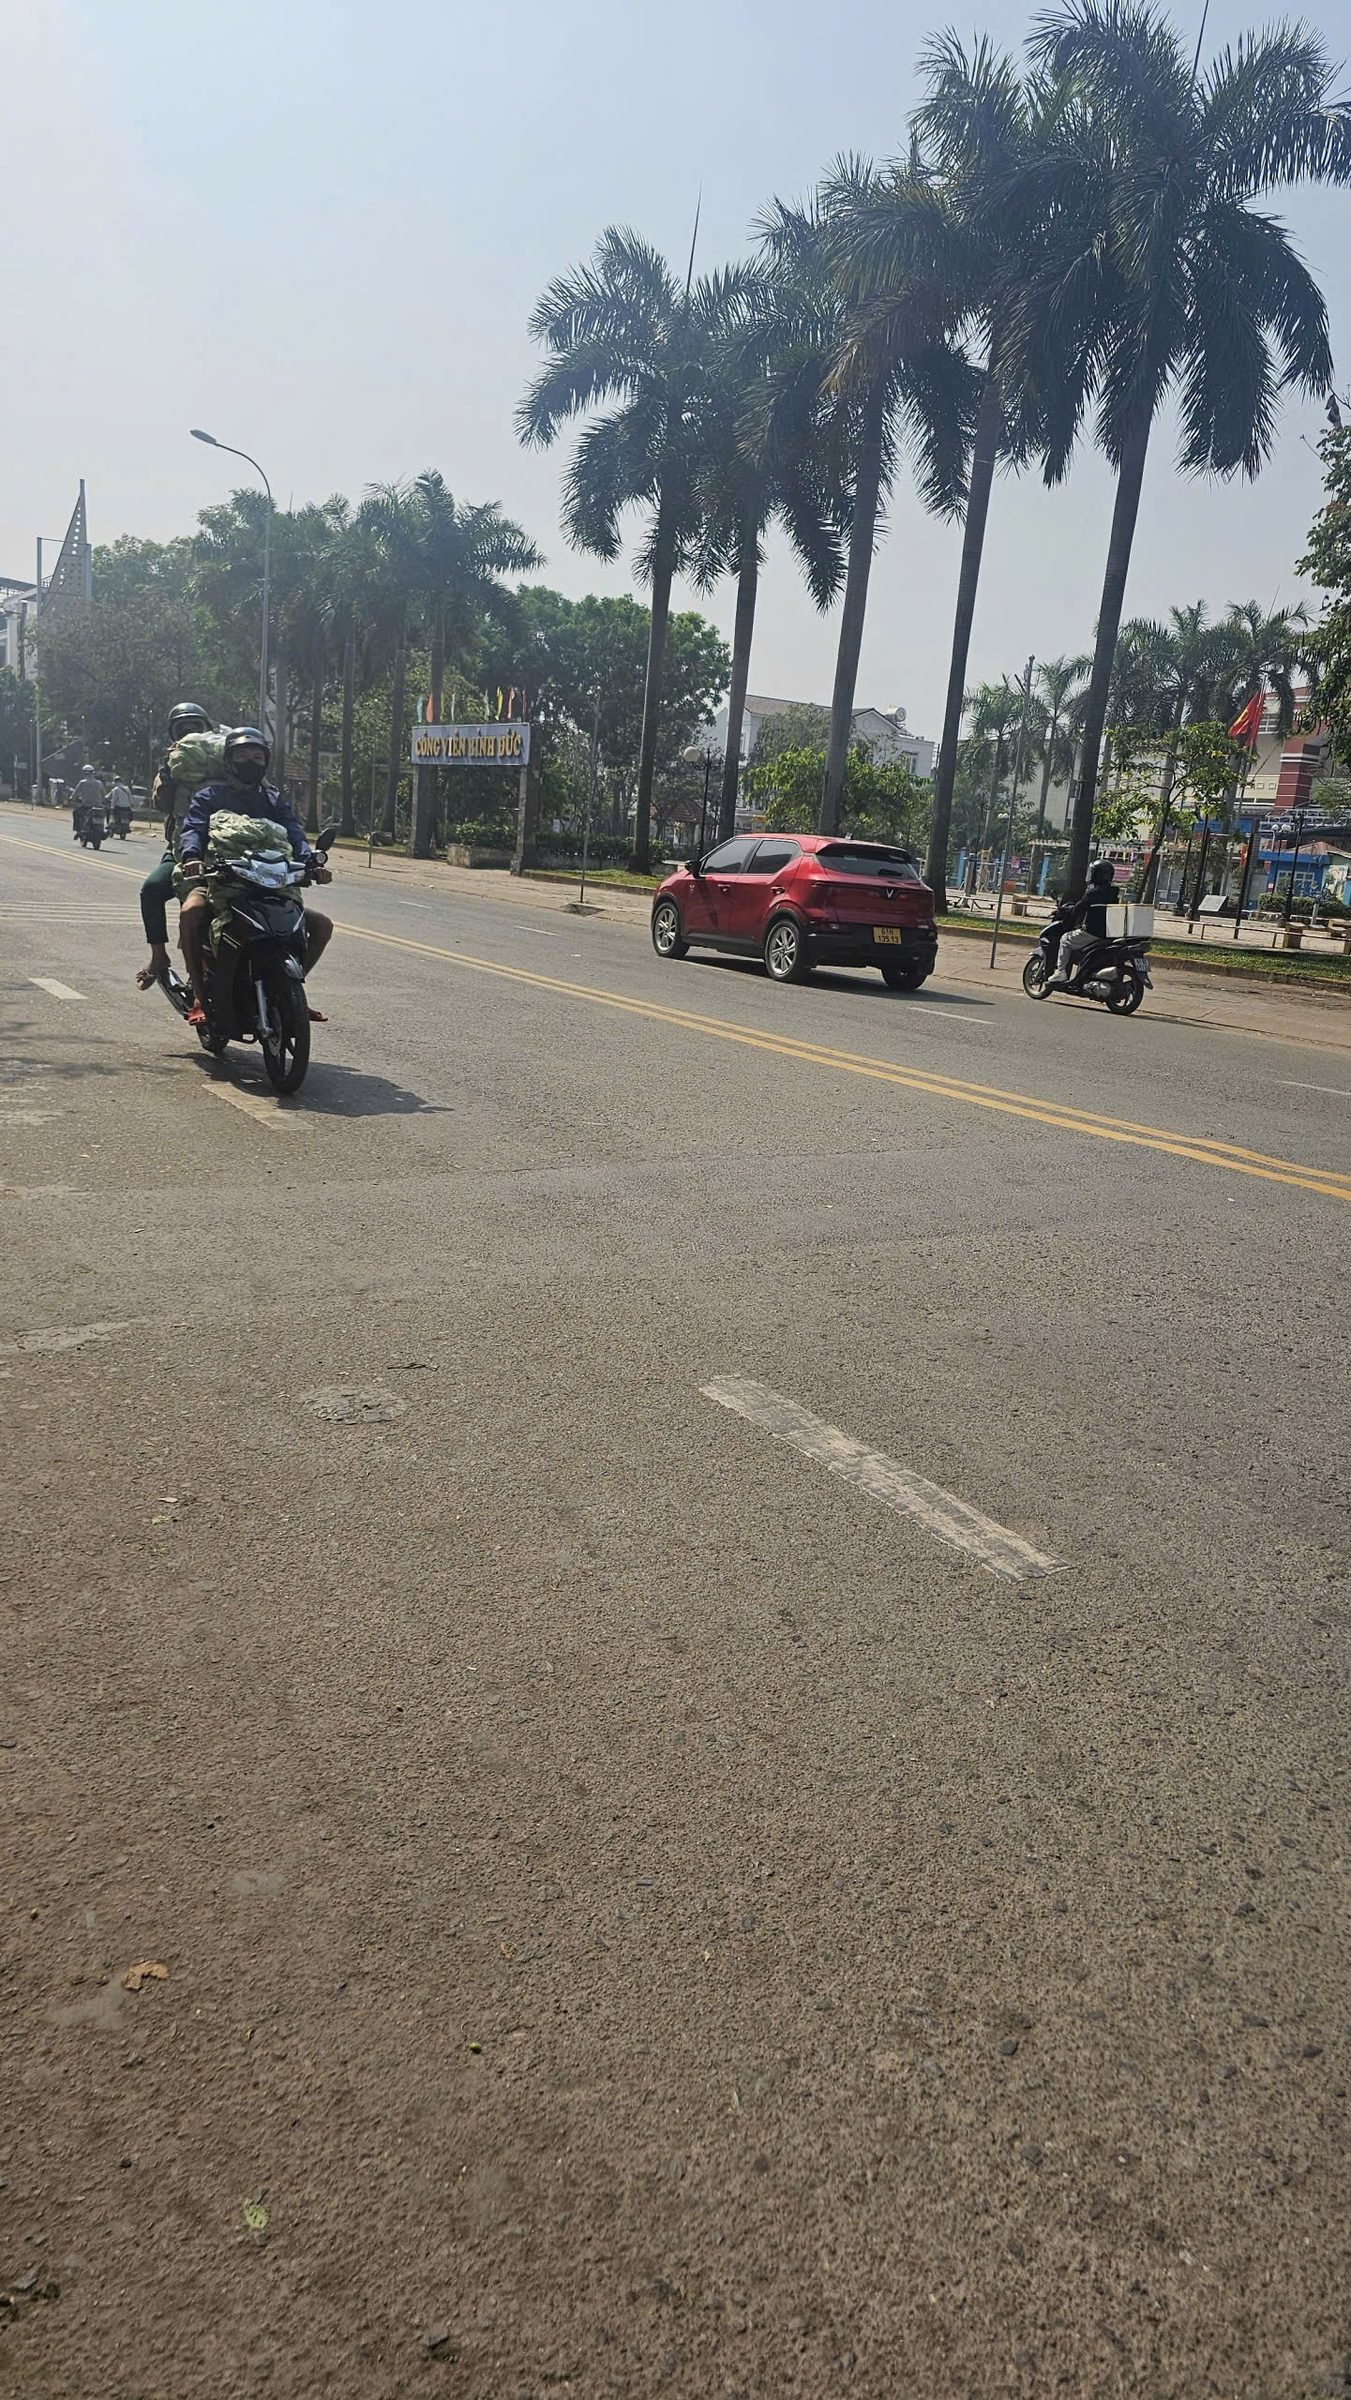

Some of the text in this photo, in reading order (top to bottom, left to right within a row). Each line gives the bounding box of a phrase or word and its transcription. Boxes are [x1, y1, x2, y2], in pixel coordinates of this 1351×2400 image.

[416, 727, 521, 756] CÔNG VIÊN BÌNH ĐỨC
